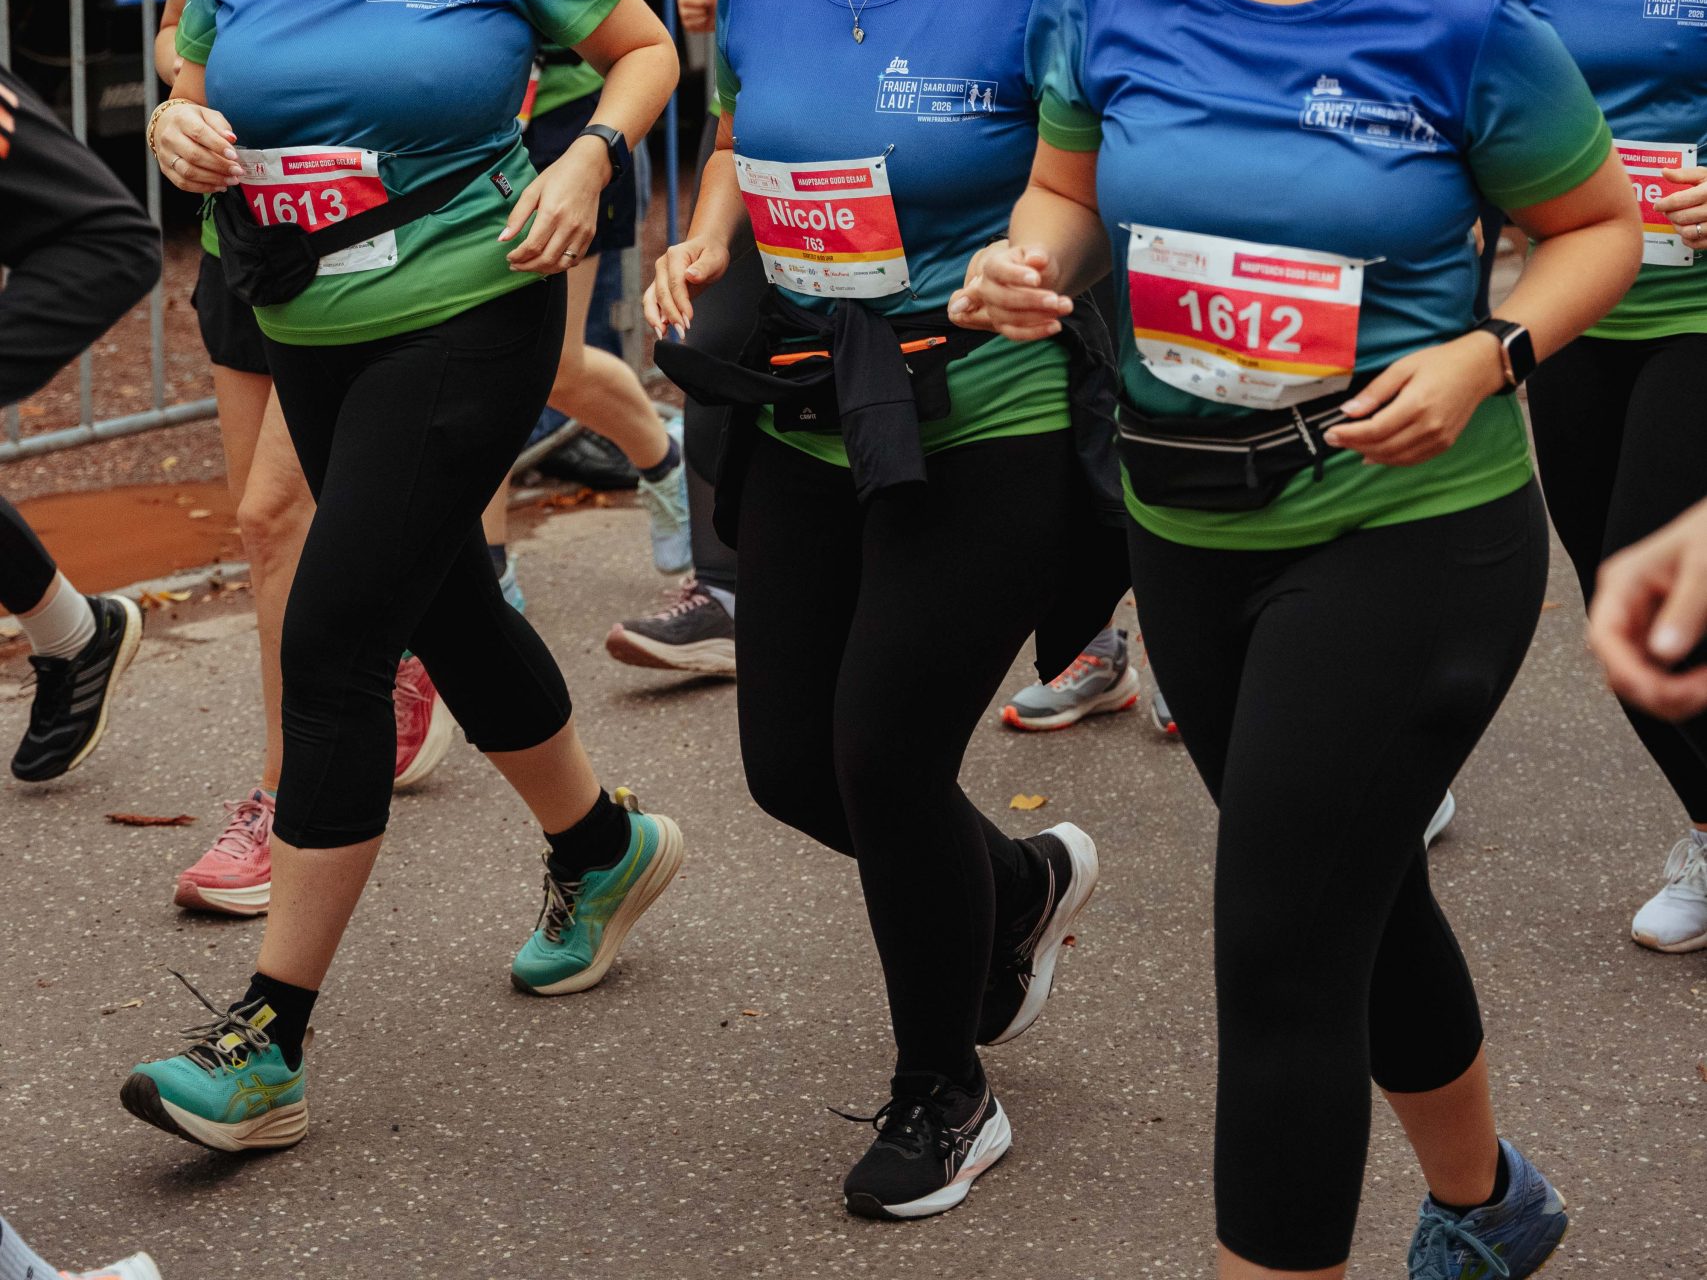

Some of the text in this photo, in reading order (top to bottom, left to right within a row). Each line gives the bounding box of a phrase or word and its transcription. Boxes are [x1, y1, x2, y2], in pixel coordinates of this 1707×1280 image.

[1646, 4, 1676, 16] LAUF
[1688, 9, 1705, 19] 2026
[882, 80, 918, 93] FRAUEN
[923, 82, 964, 93] SAARLOUIS
[880, 93, 916, 109] LAUF
[931, 101, 952, 112] 2026
[1304, 110, 1352, 129] LAUF
[288, 159, 319, 169] HAUPTSACH
[1641, 154, 1657, 164] GUDD
[1657, 156, 1678, 164] GELAAF
[797, 174, 867, 186] HAUPTSACH GUDD GELAAF
[253, 188, 348, 227] 1613
[766, 198, 855, 231] Nicole
[803, 236, 825, 252] 763
[1178, 289, 1304, 353] 1612
